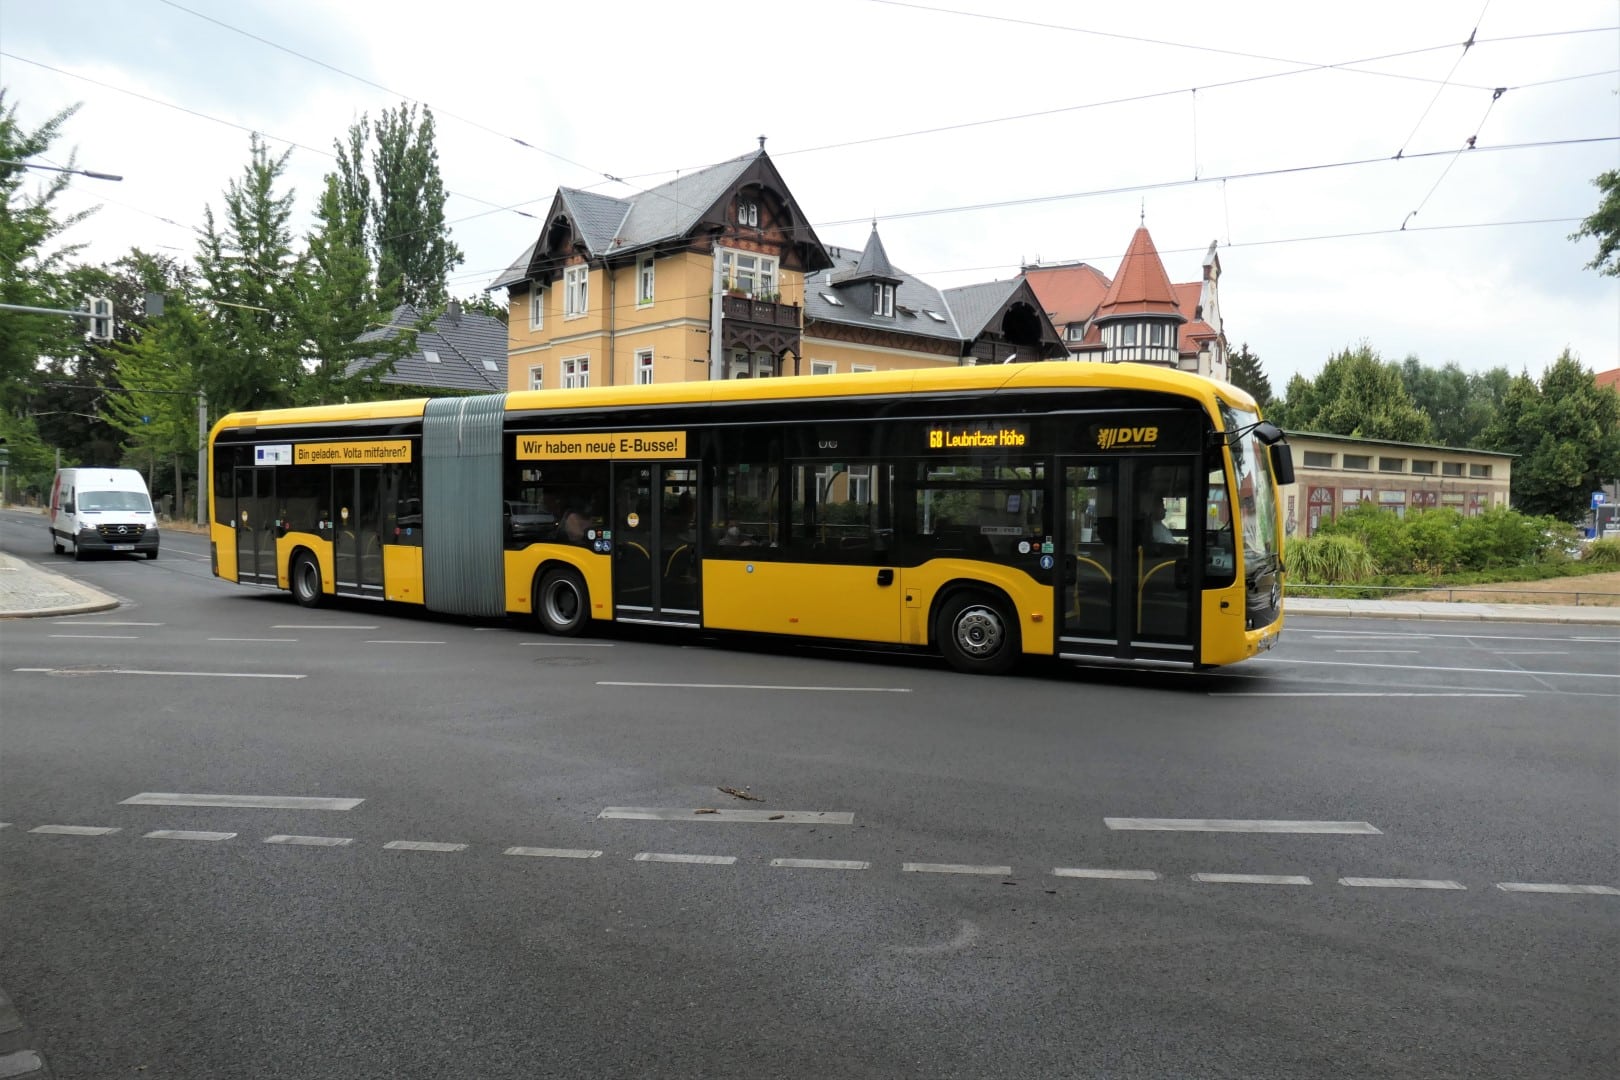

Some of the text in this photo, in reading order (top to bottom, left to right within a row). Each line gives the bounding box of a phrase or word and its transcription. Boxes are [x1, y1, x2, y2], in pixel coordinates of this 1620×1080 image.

[930, 429, 1025, 448] 68 Leubnitzer Höhe
[1117, 427, 1158, 443] DVB
[298, 449, 310, 460] Bin
[311, 448, 341, 461] geladen.
[343, 447, 362, 459] Volta
[364, 445, 407, 458] mitfahren?
[523, 438, 678, 454] Wir haben neue E-Busse!
